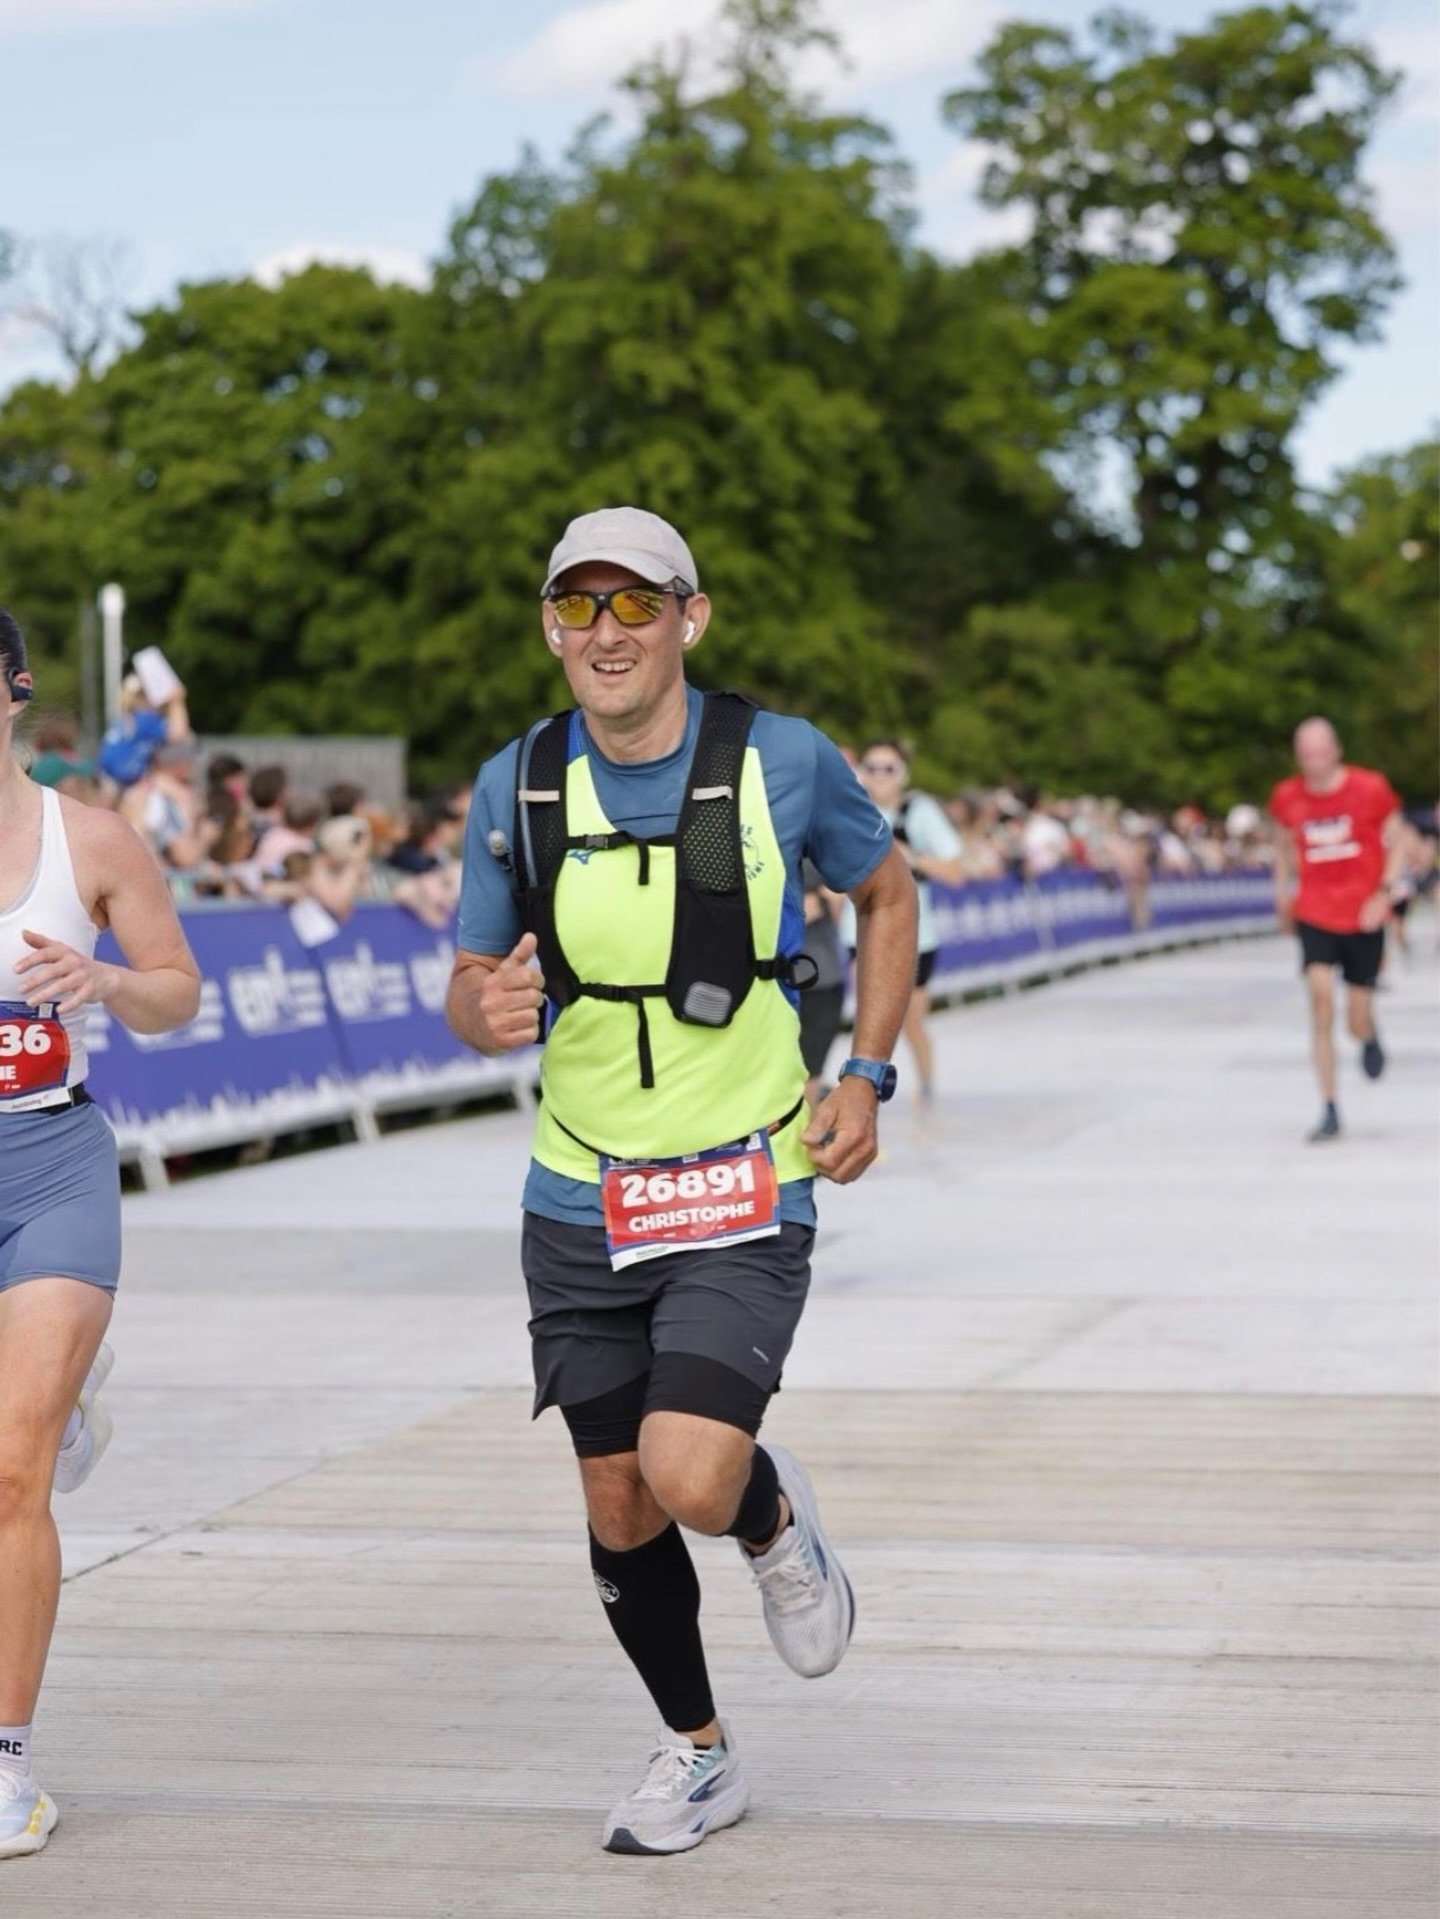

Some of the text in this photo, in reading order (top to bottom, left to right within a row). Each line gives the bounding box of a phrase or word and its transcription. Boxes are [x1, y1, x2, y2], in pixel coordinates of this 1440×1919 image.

[0, 1024, 51, 1057] 36
[620, 1160, 755, 1208] 26891
[629, 1201, 755, 1233] CHRISTOPHE
